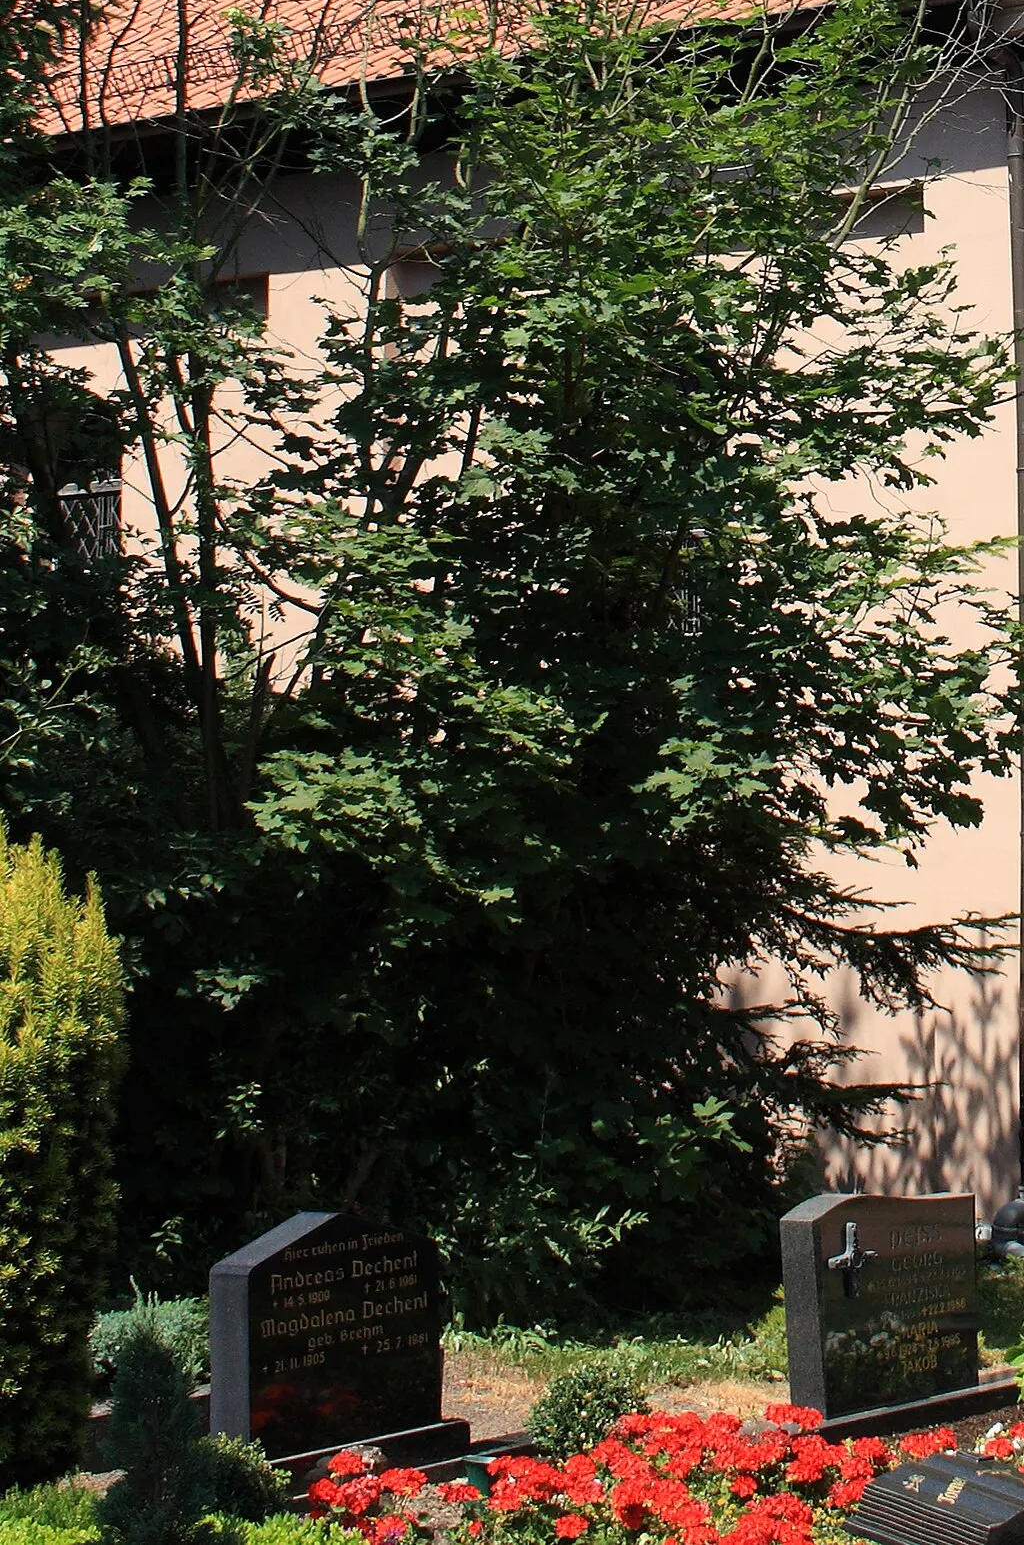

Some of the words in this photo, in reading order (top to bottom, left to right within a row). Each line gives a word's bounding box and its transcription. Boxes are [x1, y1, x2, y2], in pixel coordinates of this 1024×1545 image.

[347, 1237, 359, 1251] in
[362, 1231, 405, 1251] Frieden
[270, 1267, 346, 1295] Andreas
[351, 1251, 418, 1278] Dechent
[260, 1308, 356, 1338] Magdalena
[361, 1291, 428, 1320] Dechent
[307, 1333, 336, 1352] geb.
[901, 1353, 938, 1375] JAKOB
